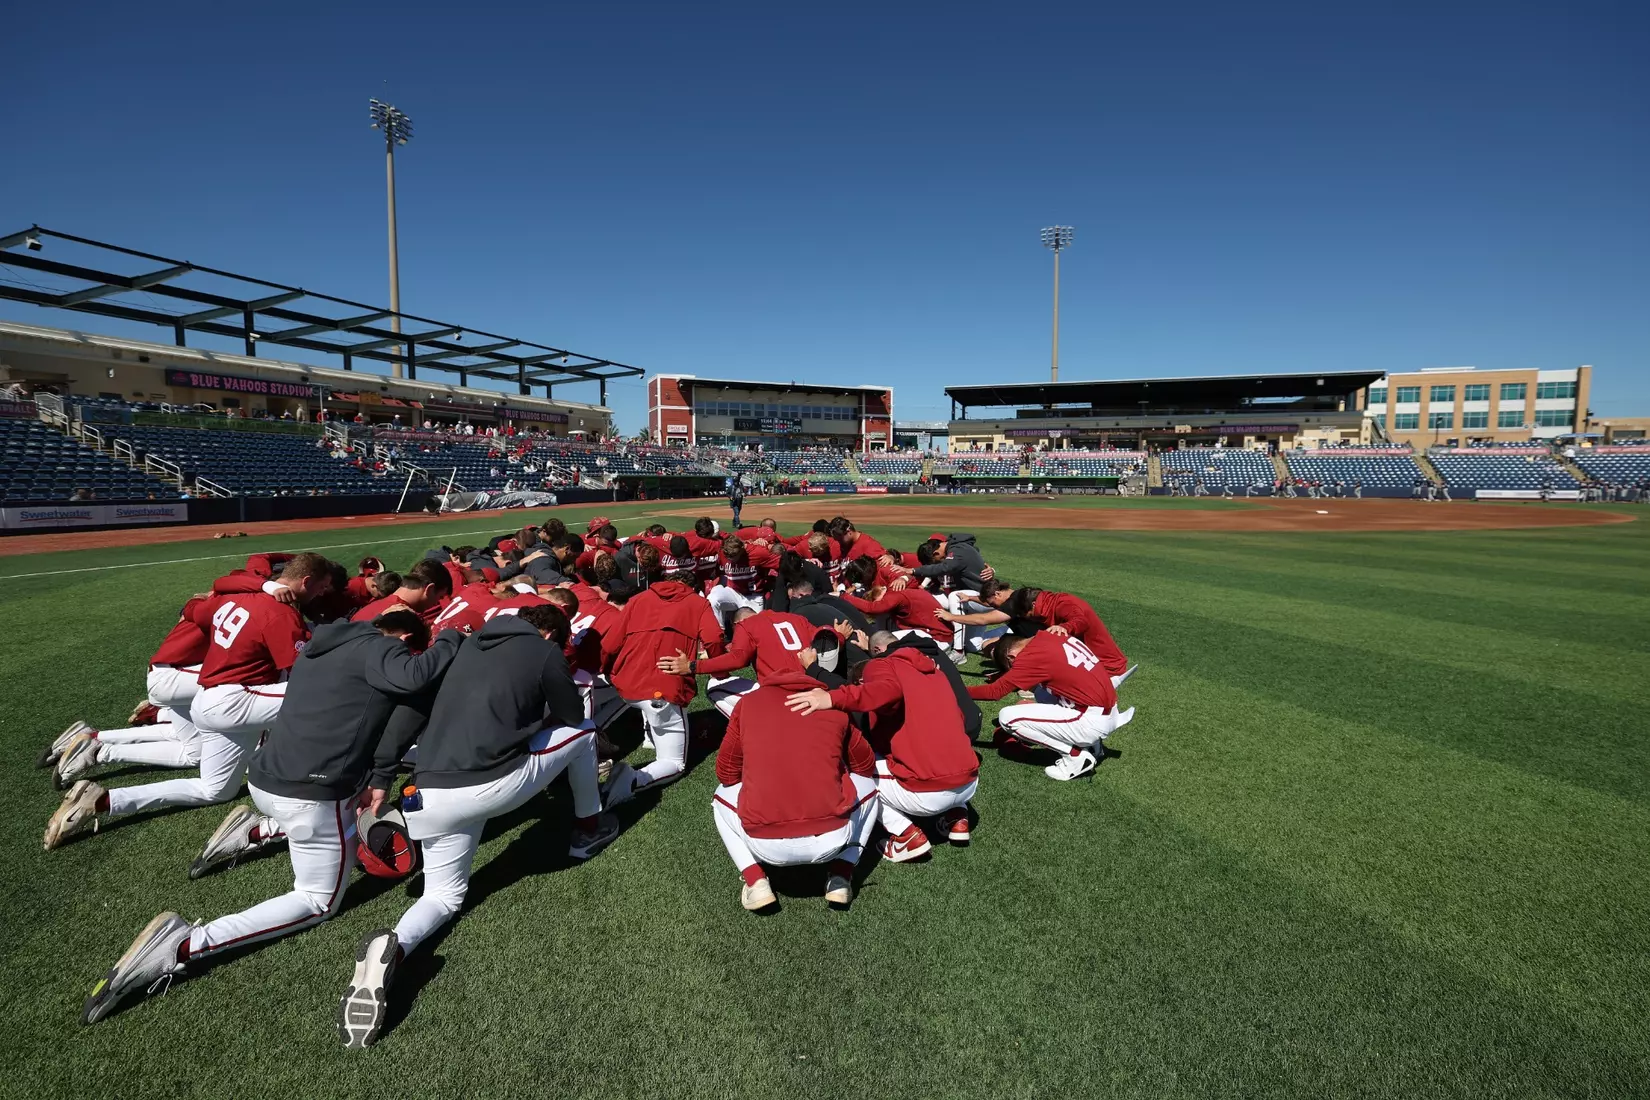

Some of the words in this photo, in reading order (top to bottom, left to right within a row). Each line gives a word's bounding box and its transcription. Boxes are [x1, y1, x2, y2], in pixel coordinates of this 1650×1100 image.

[190, 373, 220, 388] BLUE
[223, 377, 267, 393] WAHOOS
[270, 383, 313, 398] STADIUM
[20, 509, 92, 519] Sweetwater
[117, 507, 175, 516] Sweetwater
[724, 562, 756, 574] Alabama
[212, 600, 250, 650] 49
[1062, 636, 1100, 672] 40
